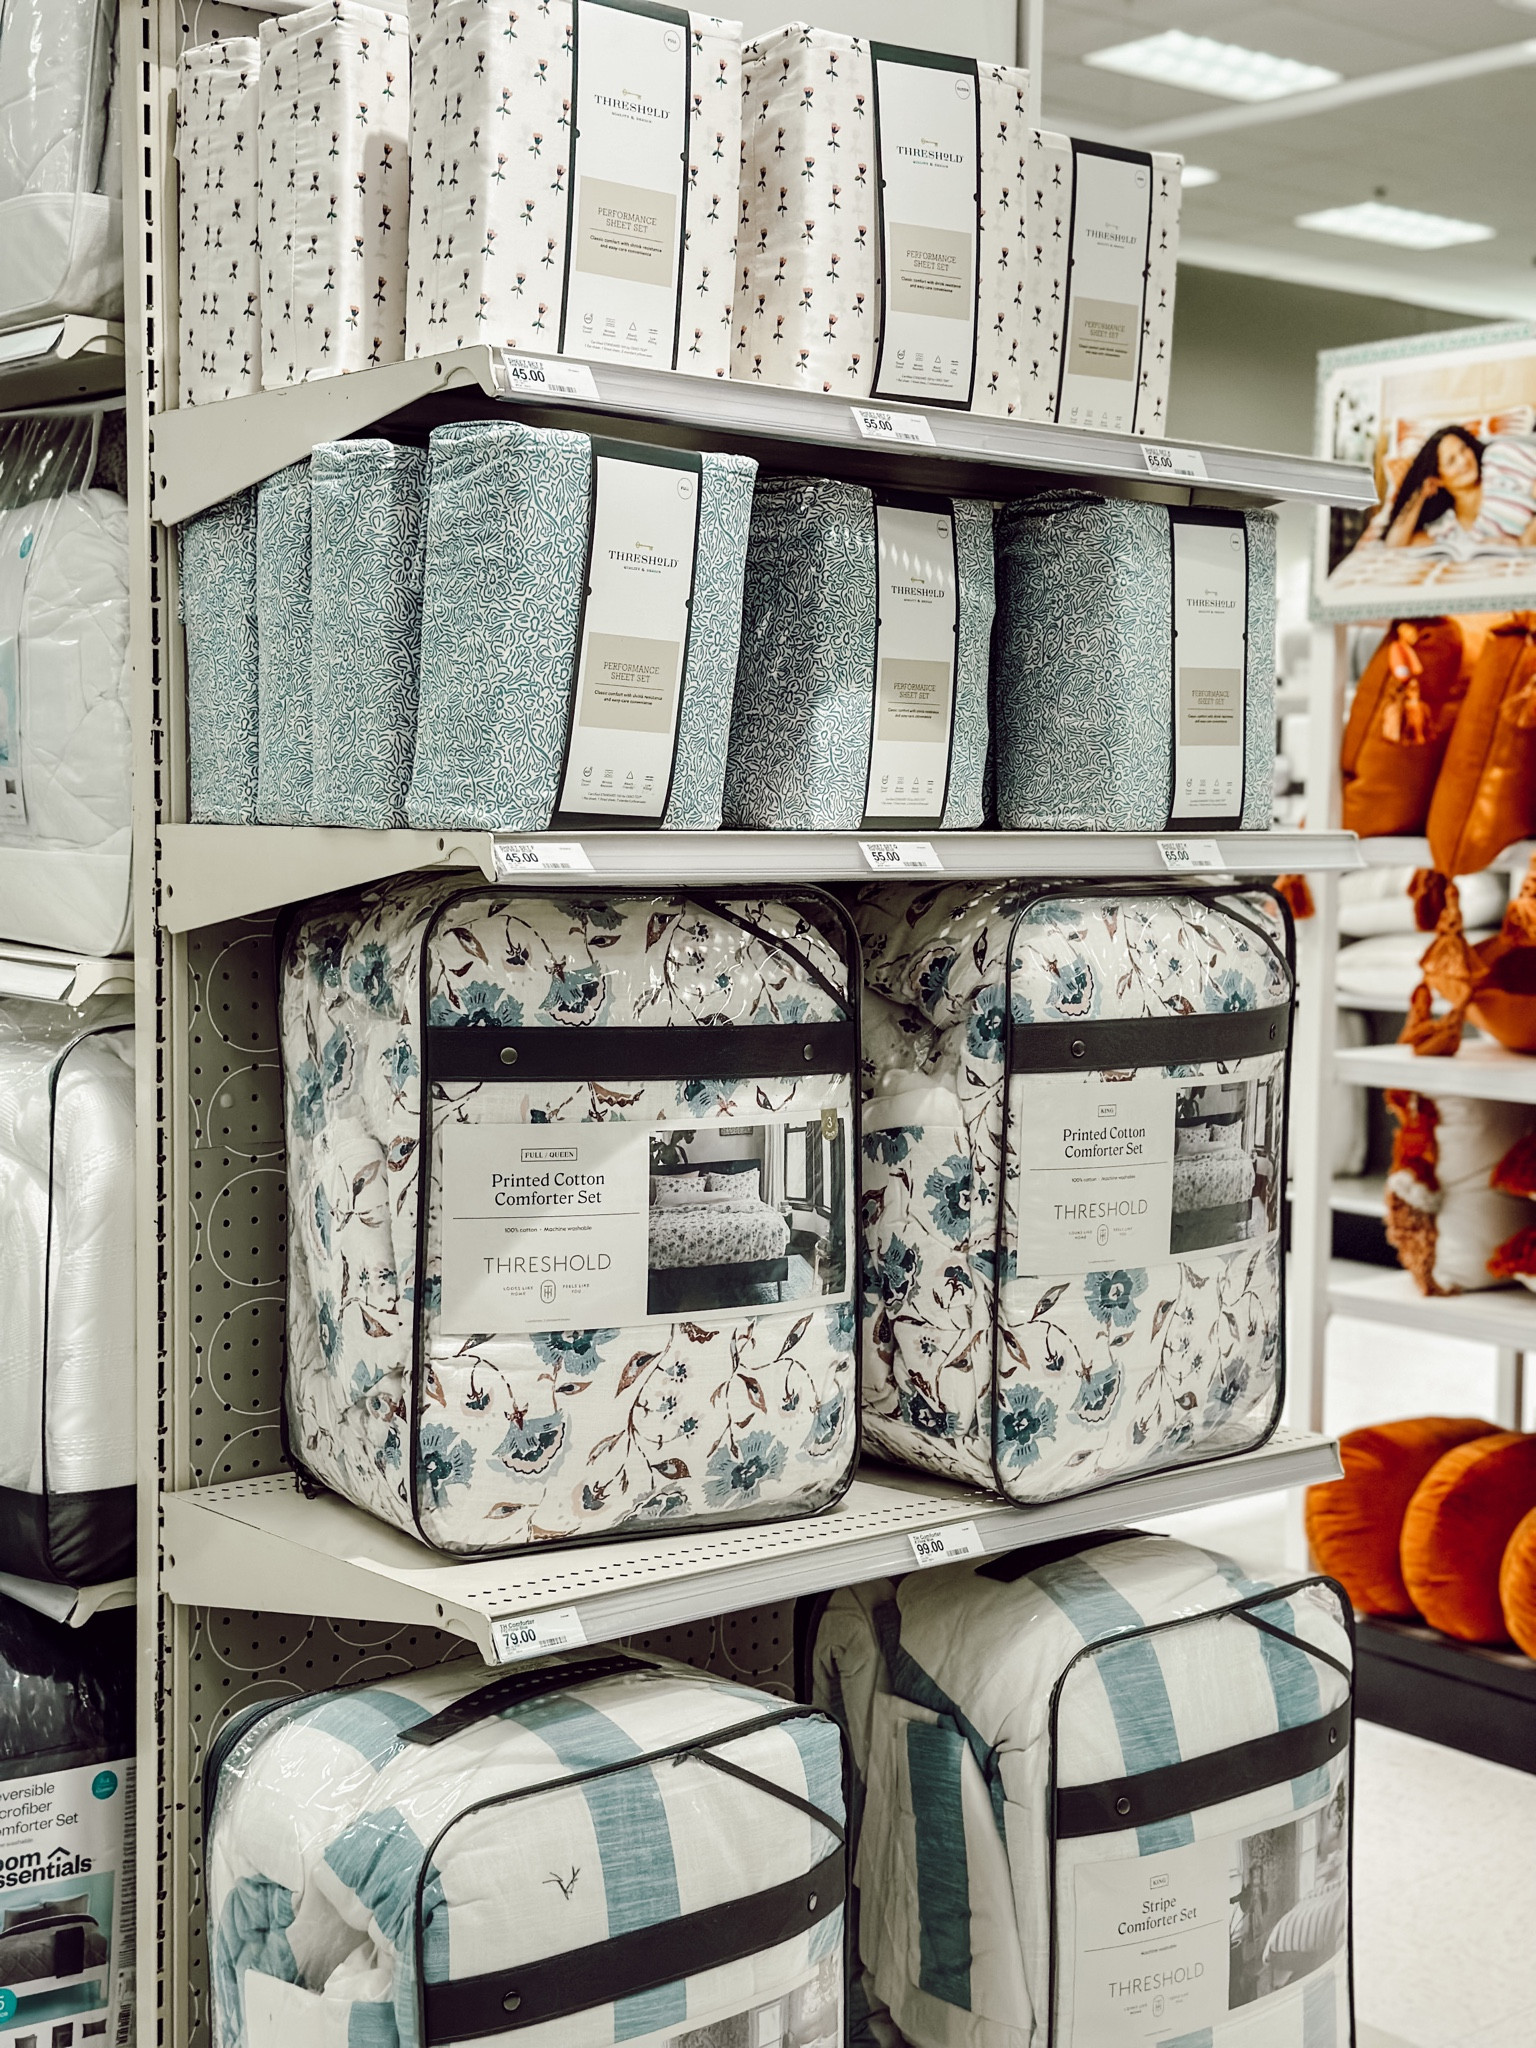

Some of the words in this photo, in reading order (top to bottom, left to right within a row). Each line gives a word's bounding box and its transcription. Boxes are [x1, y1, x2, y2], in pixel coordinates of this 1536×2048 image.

[594, 94, 670, 119] THRESHOLD
[896, 146, 964, 164] THRESHOLD
[598, 207, 657, 226] PERFORMANCE
[606, 218, 632, 231] SHEET
[633, 224, 648, 233] SET
[1086, 229, 1137, 244] THRESHOLD
[906, 250, 956, 264] PERFORMANCE
[914, 260, 935, 270] SHEET
[937, 263, 949, 271] SET
[512, 368, 545, 382] 45.00
[864, 419, 892, 431] 55.00
[1148, 455, 1172, 467] 65.00
[608, 550, 678, 568] THRESHOLD
[891, 585, 945, 598] THRESHOLD
[1187, 598, 1236, 608] THRESHOLD
[603, 662, 660, 674] PERFORMANCE
[610, 672, 635, 681] SHEET
[636, 675, 650, 683] SET
[893, 682, 936, 692] PERFORMANCE
[899, 691, 917, 699] SHEET
[506, 853, 538, 862] 45.00
[872, 852, 900, 861] 55.00
[1165, 850, 1189, 860] 65.00
[827, 1116, 832, 1128] 3
[1063, 1127, 1107, 1142] Printed
[1109, 1127, 1145, 1139] Cotton
[1064, 1144, 1124, 1158] Comforter
[1126, 1143, 1143, 1155] Set
[492, 1173, 550, 1188] Printed
[554, 1172, 605, 1186] Cotton
[495, 1191, 574, 1206] Comforter
[578, 1190, 602, 1204] Set
[1054, 1199, 1148, 1220] THRESHOLD
[483, 1253, 611, 1274] THRESHOLD
[917, 1540, 944, 1555] 99.00
[502, 1629, 536, 1646] 79.00
[0, 1782, 55, 1801] versible
[0, 1818, 53, 1836] mforter
[56, 1813, 78, 1826] Set
[1153, 1878, 1166, 1886] KING
[1142, 1897, 1177, 1914] Stripe
[1118, 1913, 1178, 1935] Comforter
[1180, 1908, 1197, 1922] Set
[1109, 1962, 1204, 1998] THRESHOLD
